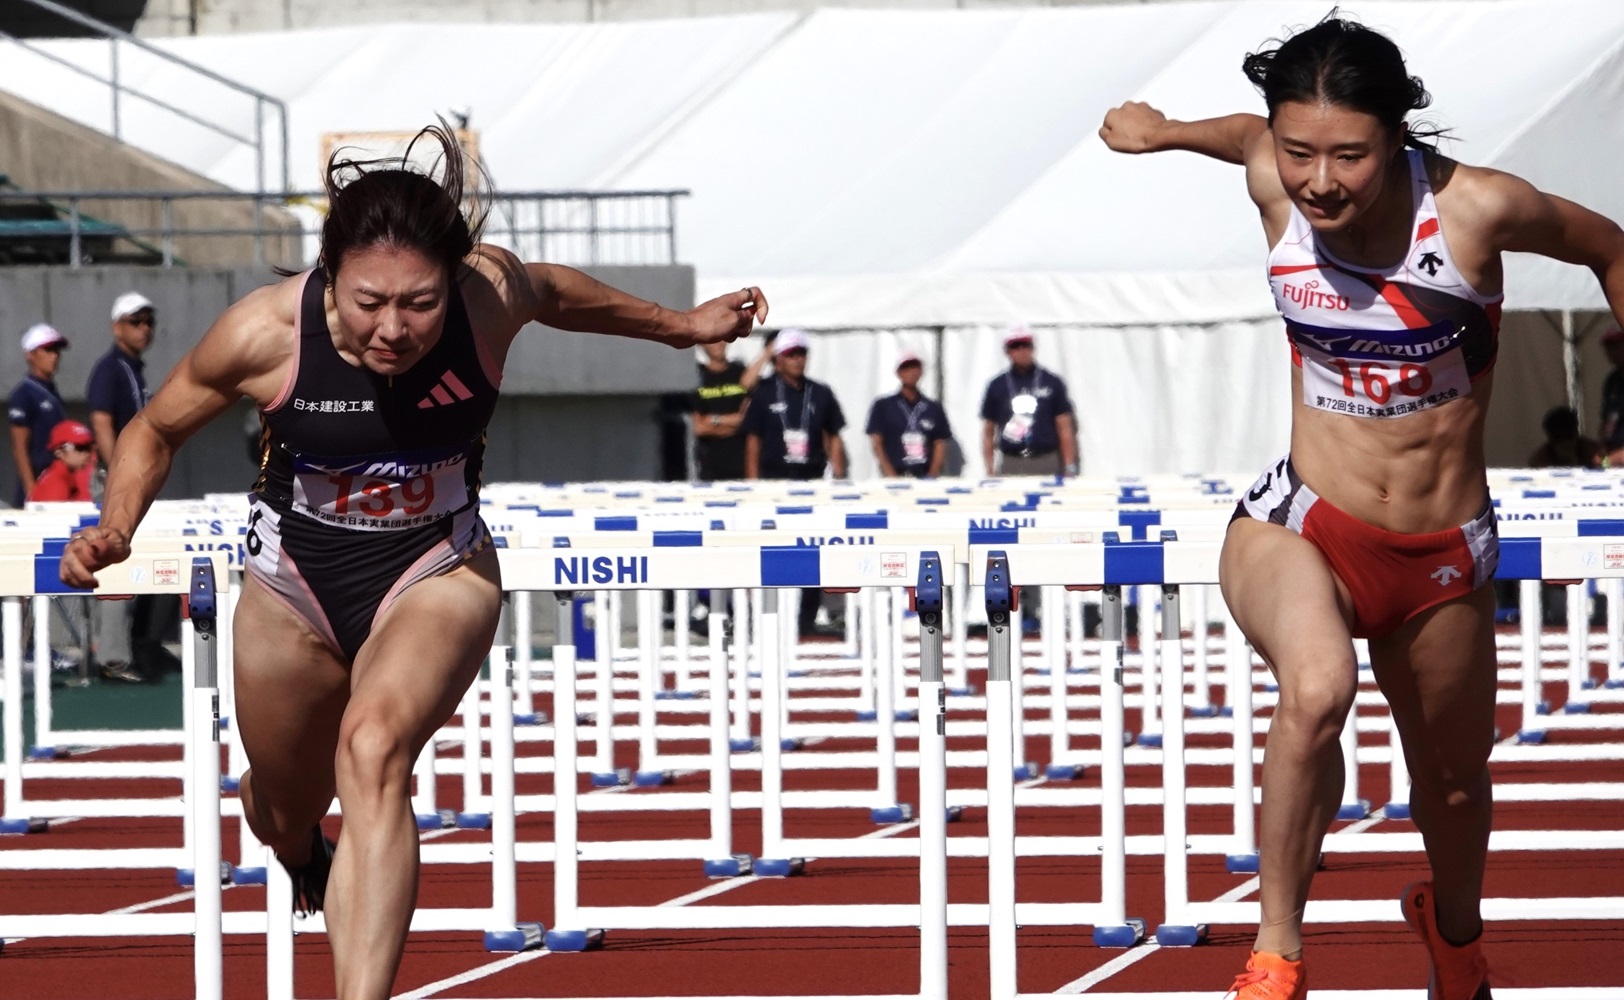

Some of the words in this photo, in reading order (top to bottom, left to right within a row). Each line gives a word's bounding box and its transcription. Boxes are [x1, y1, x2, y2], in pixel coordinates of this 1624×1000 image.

[1282, 280, 1350, 312] FUJITSU
[1348, 335, 1451, 357] MIZUNO
[1327, 358, 1433, 406] 168
[293, 398, 375, 413] 日本建設工業
[1316, 386, 1458, 418] 第72回全日本実業団選手権大会
[362, 452, 464, 479] MIZUNO
[328, 474, 435, 518] 139
[554, 556, 648, 585] NISHI
